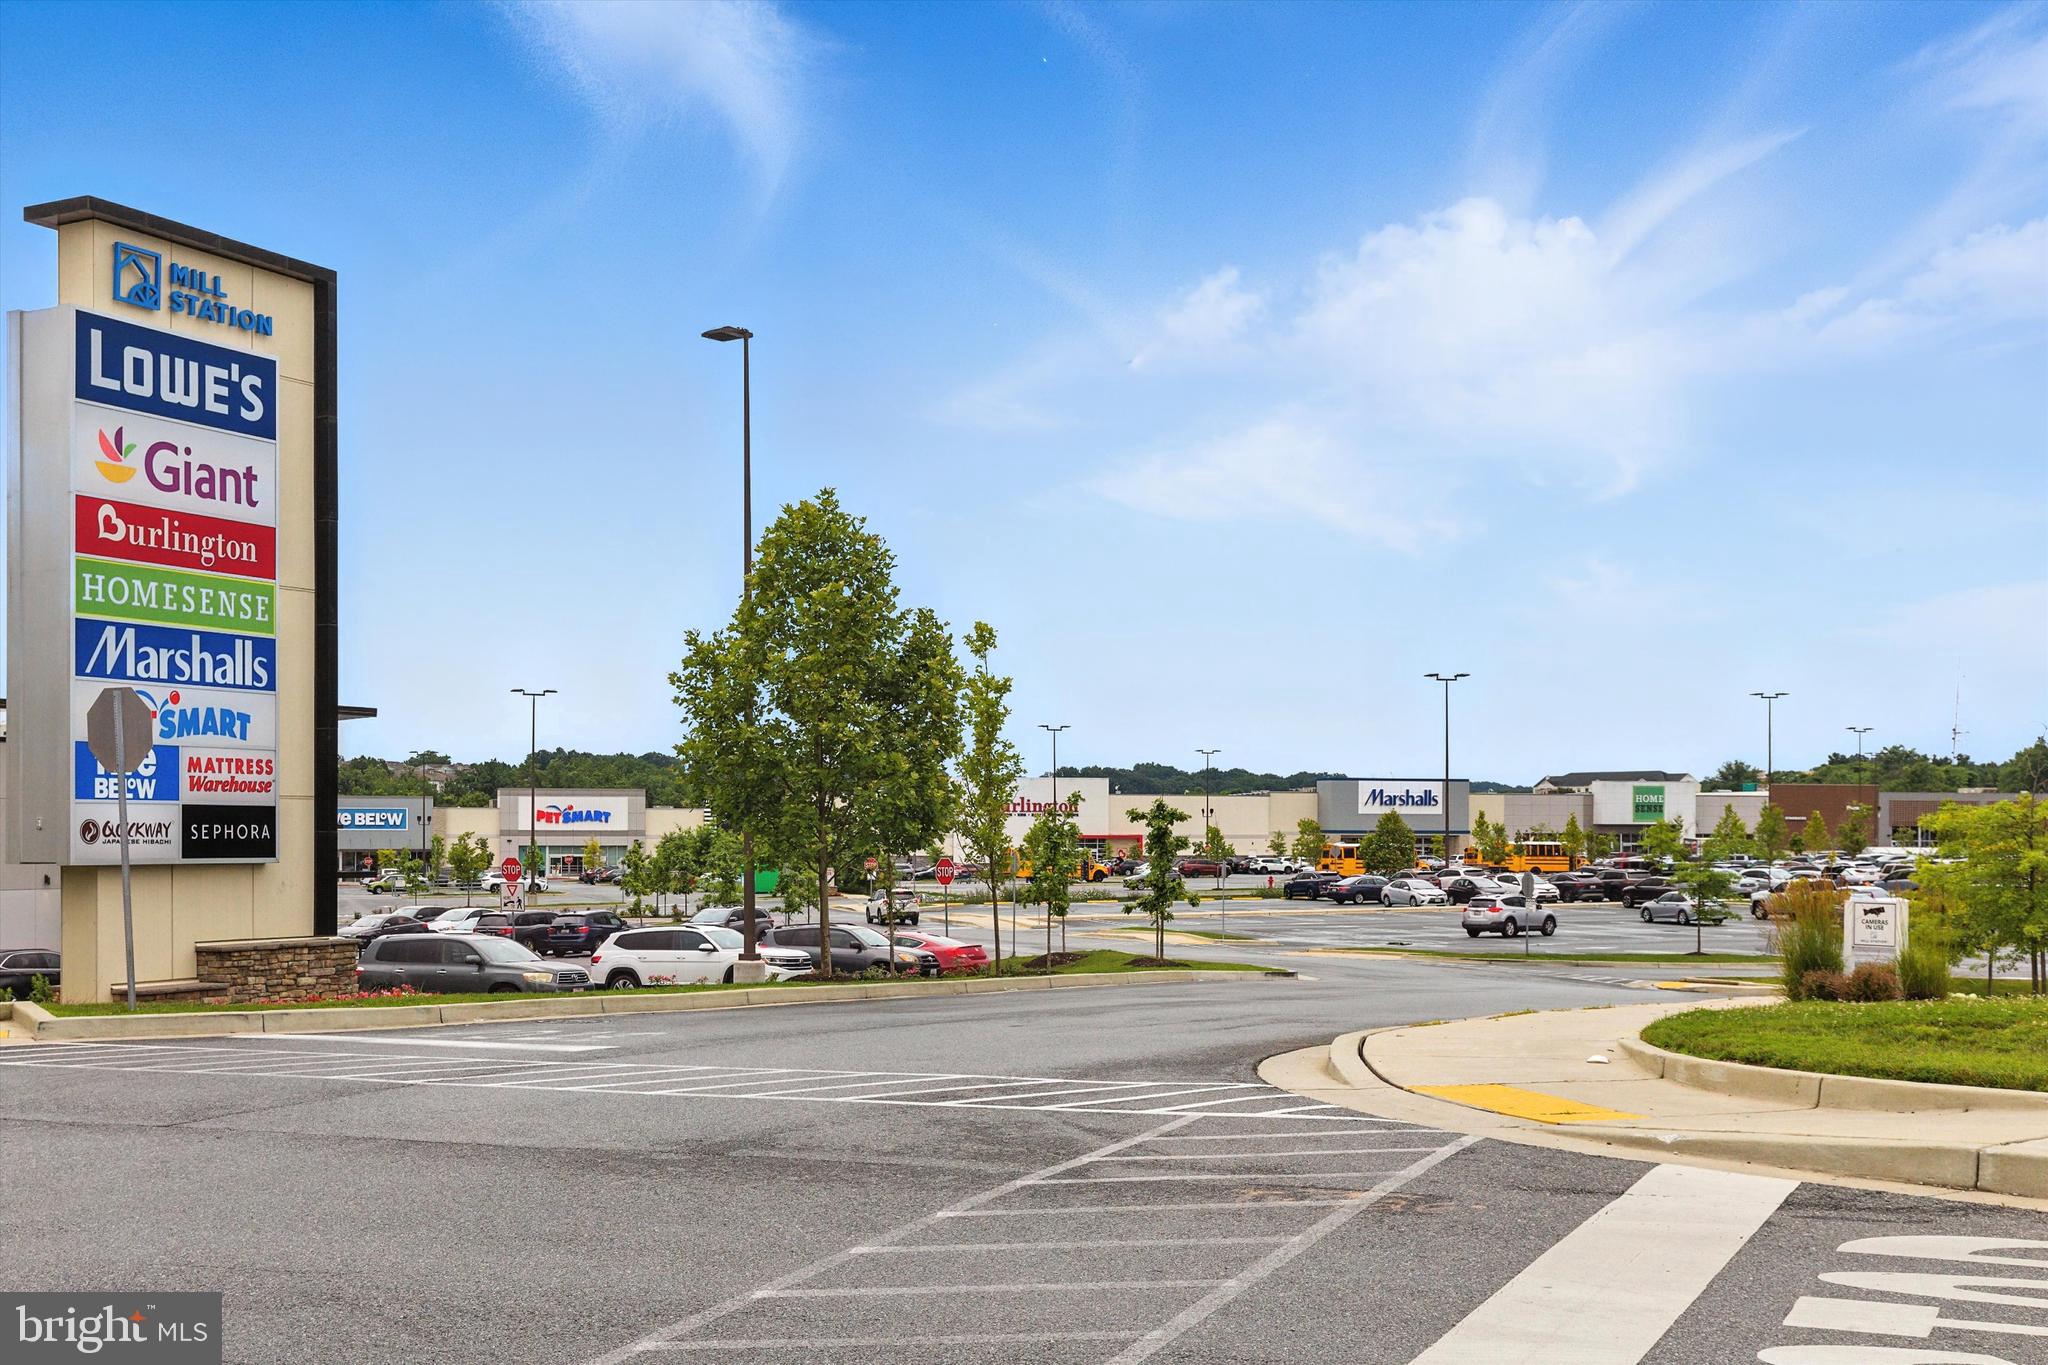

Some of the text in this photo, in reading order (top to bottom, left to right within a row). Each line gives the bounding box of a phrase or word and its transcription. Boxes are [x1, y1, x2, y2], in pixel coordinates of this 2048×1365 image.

[170, 262, 228, 298] MILL
[170, 291, 273, 336] STATION
[90, 328, 265, 422] LOWE'S
[144, 441, 260, 508] Giant
[97, 503, 258, 566] Burlington
[82, 573, 270, 622] HOMESENSE
[85, 625, 269, 688] Marshalls
[187, 756, 274, 776] MATTRESS
[188, 776, 273, 793] Warehouse
[1364, 788, 1439, 807] Marshalls
[1635, 794, 1664, 803] HOME
[1635, 804, 1664, 813] SENSE
[191, 824, 270, 839] SEPHORA
[502, 864, 521, 875] STOP
[937, 866, 954, 877] STOP
